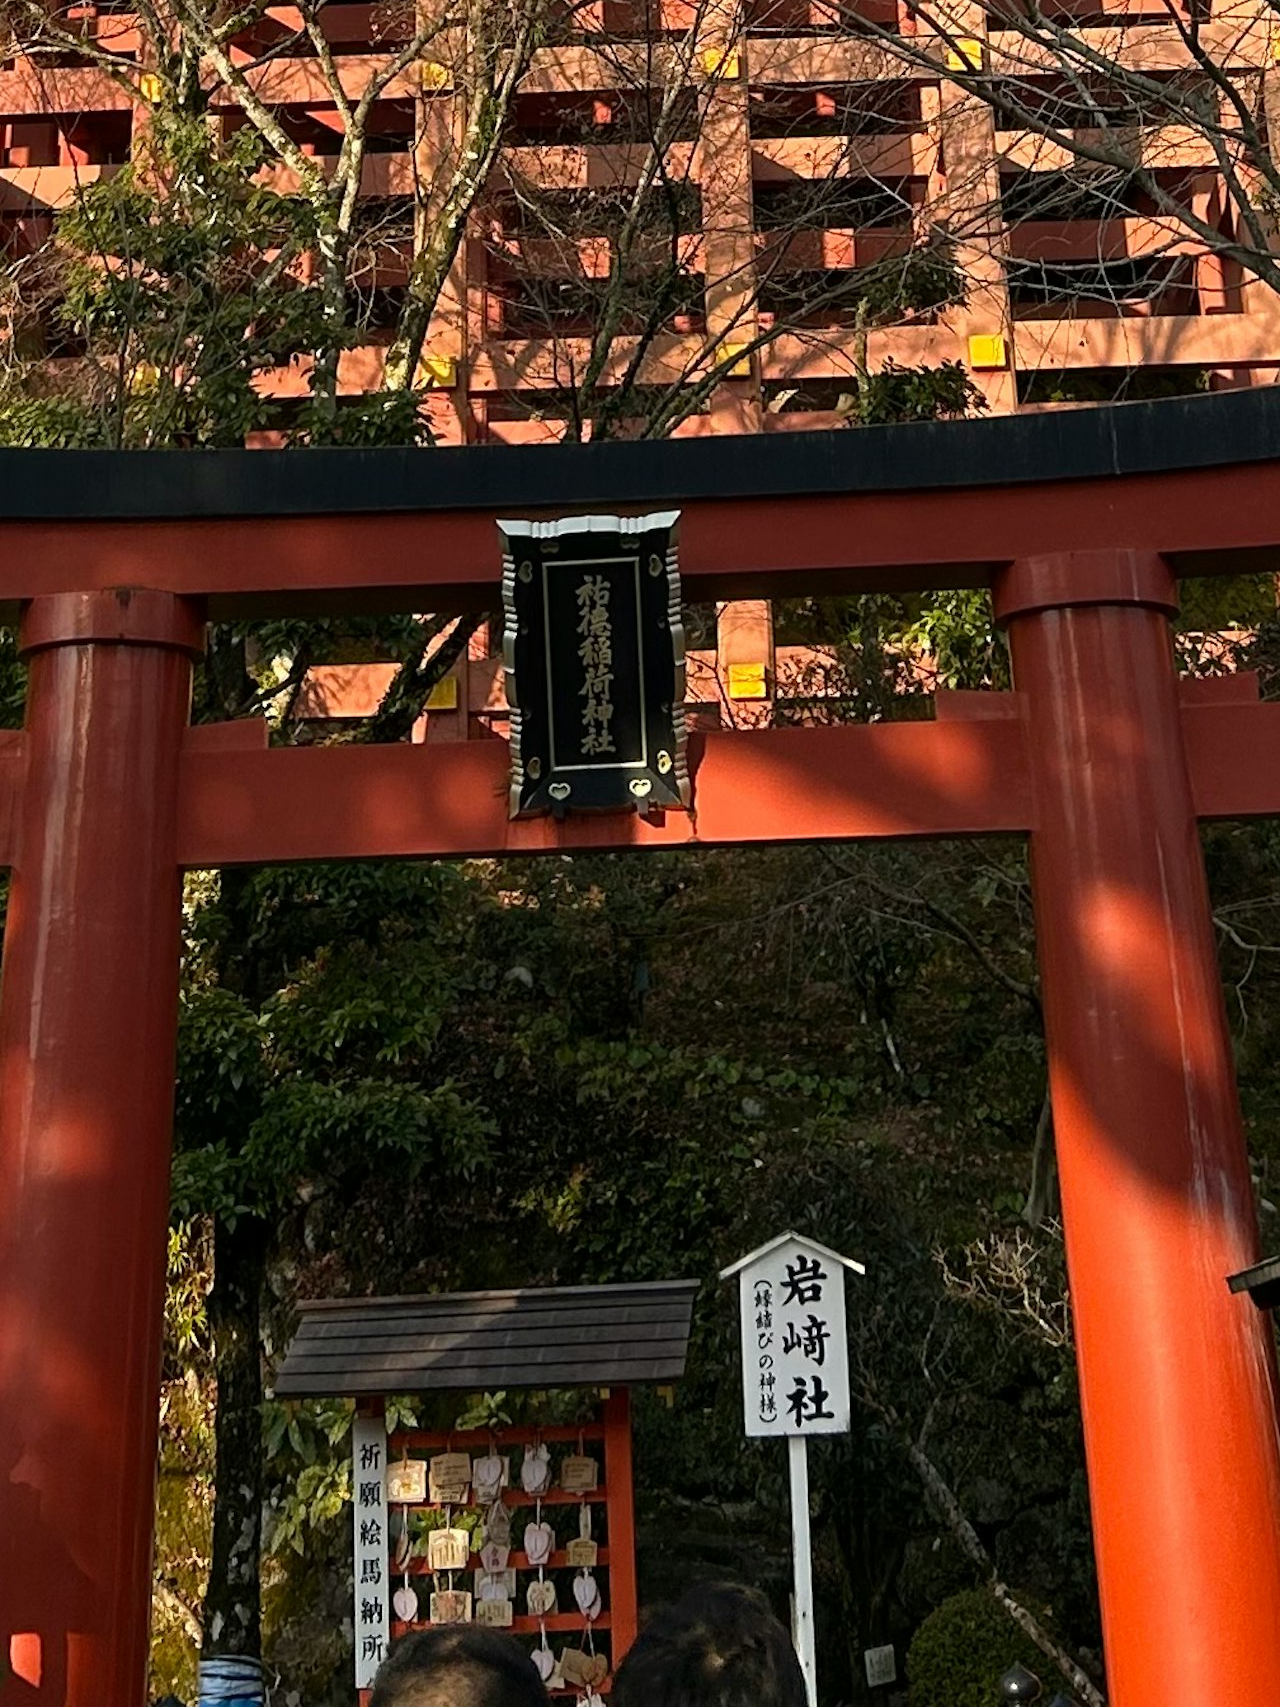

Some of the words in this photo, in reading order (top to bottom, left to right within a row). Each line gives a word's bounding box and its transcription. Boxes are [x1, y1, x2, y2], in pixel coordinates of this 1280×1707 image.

[359, 1442, 387, 1663] 祈願絵馬納所
